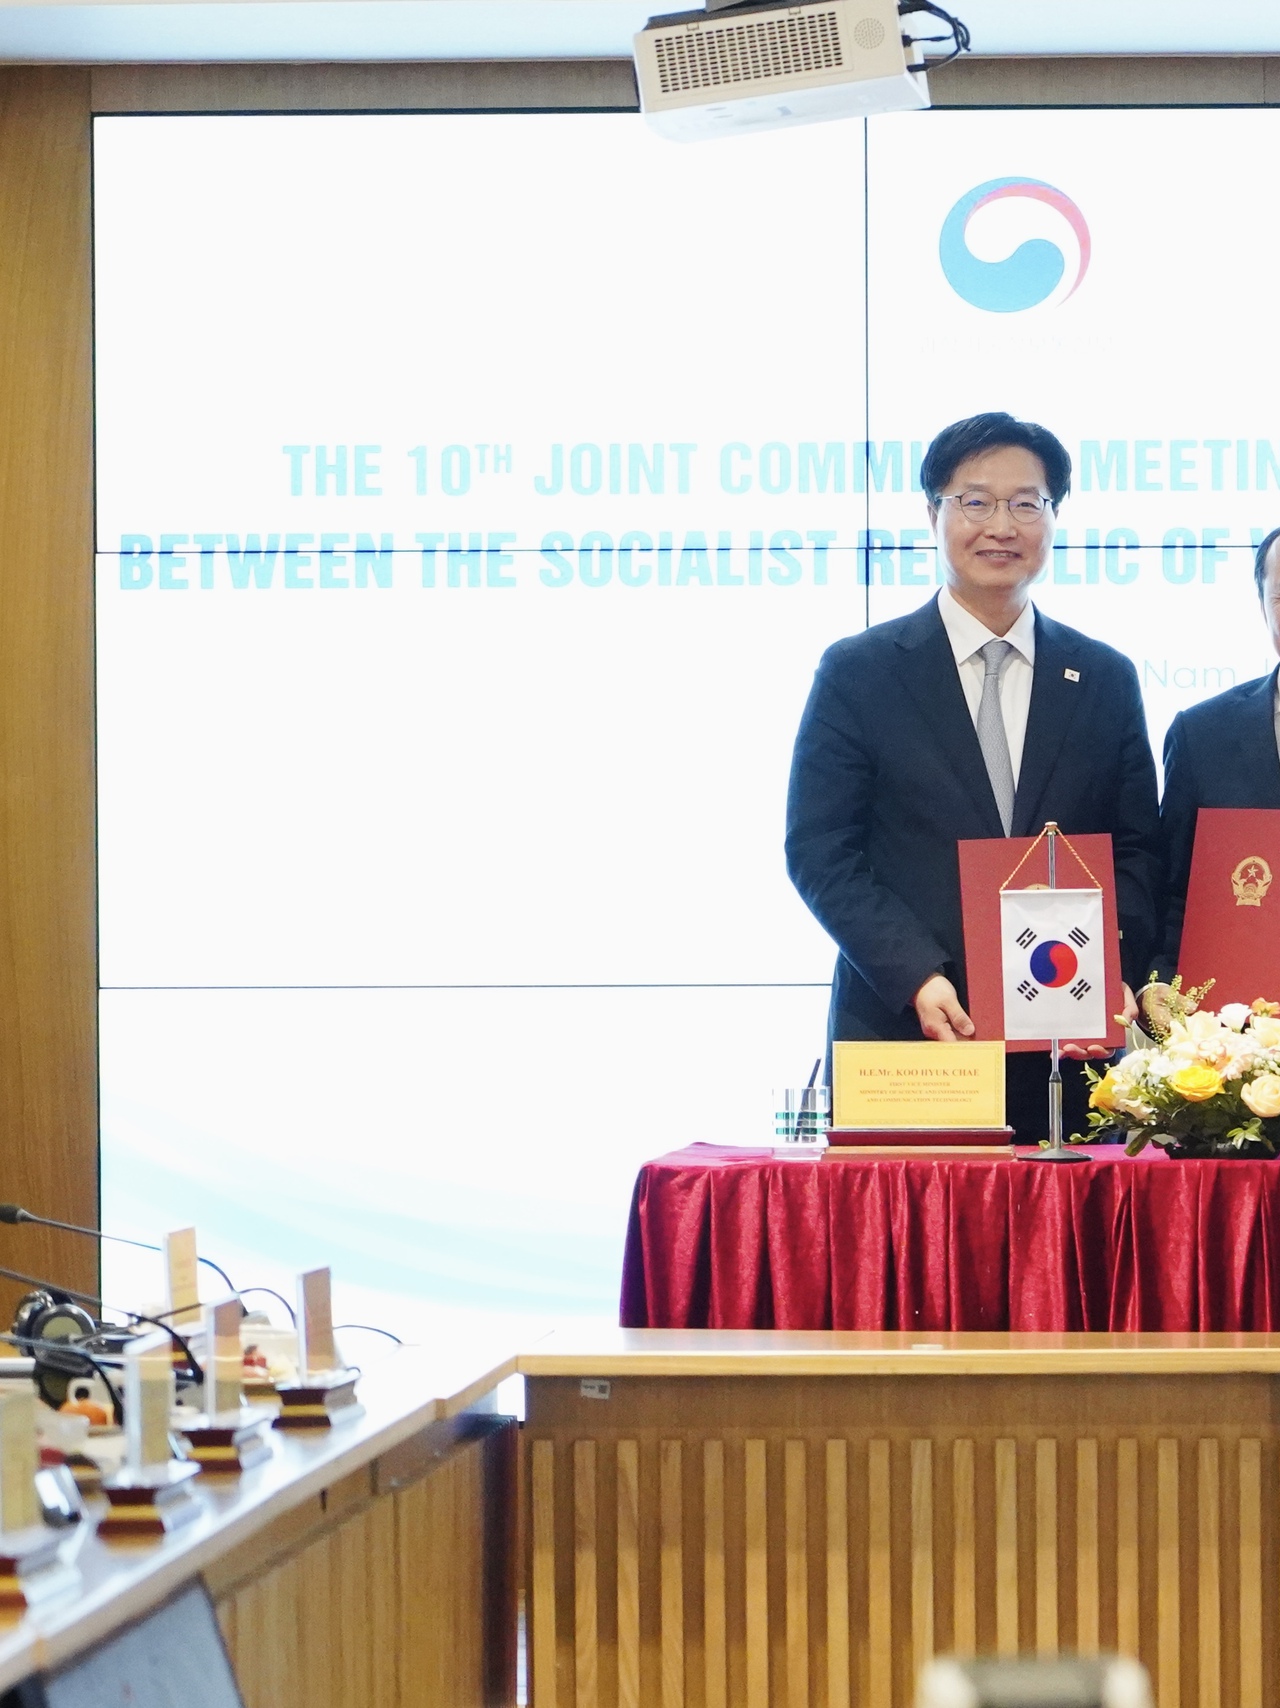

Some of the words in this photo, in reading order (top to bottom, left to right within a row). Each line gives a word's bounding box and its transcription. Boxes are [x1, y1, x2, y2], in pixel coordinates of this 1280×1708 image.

[282, 443, 384, 498] THE
[406, 442, 513, 497] 10TH
[532, 441, 698, 497] JOINT
[719, 440, 924, 496] COMMI
[119, 531, 395, 592] BETWEEN
[414, 531, 518, 589] THE
[538, 528, 838, 590] SOCIALIST
[856, 526, 1140, 587] RELIC
[1160, 526, 1230, 586] OF
[896, 1068, 919, 1077] KOO
[920, 1068, 950, 1077] HYUK
[952, 1068, 980, 1077] CHAE
